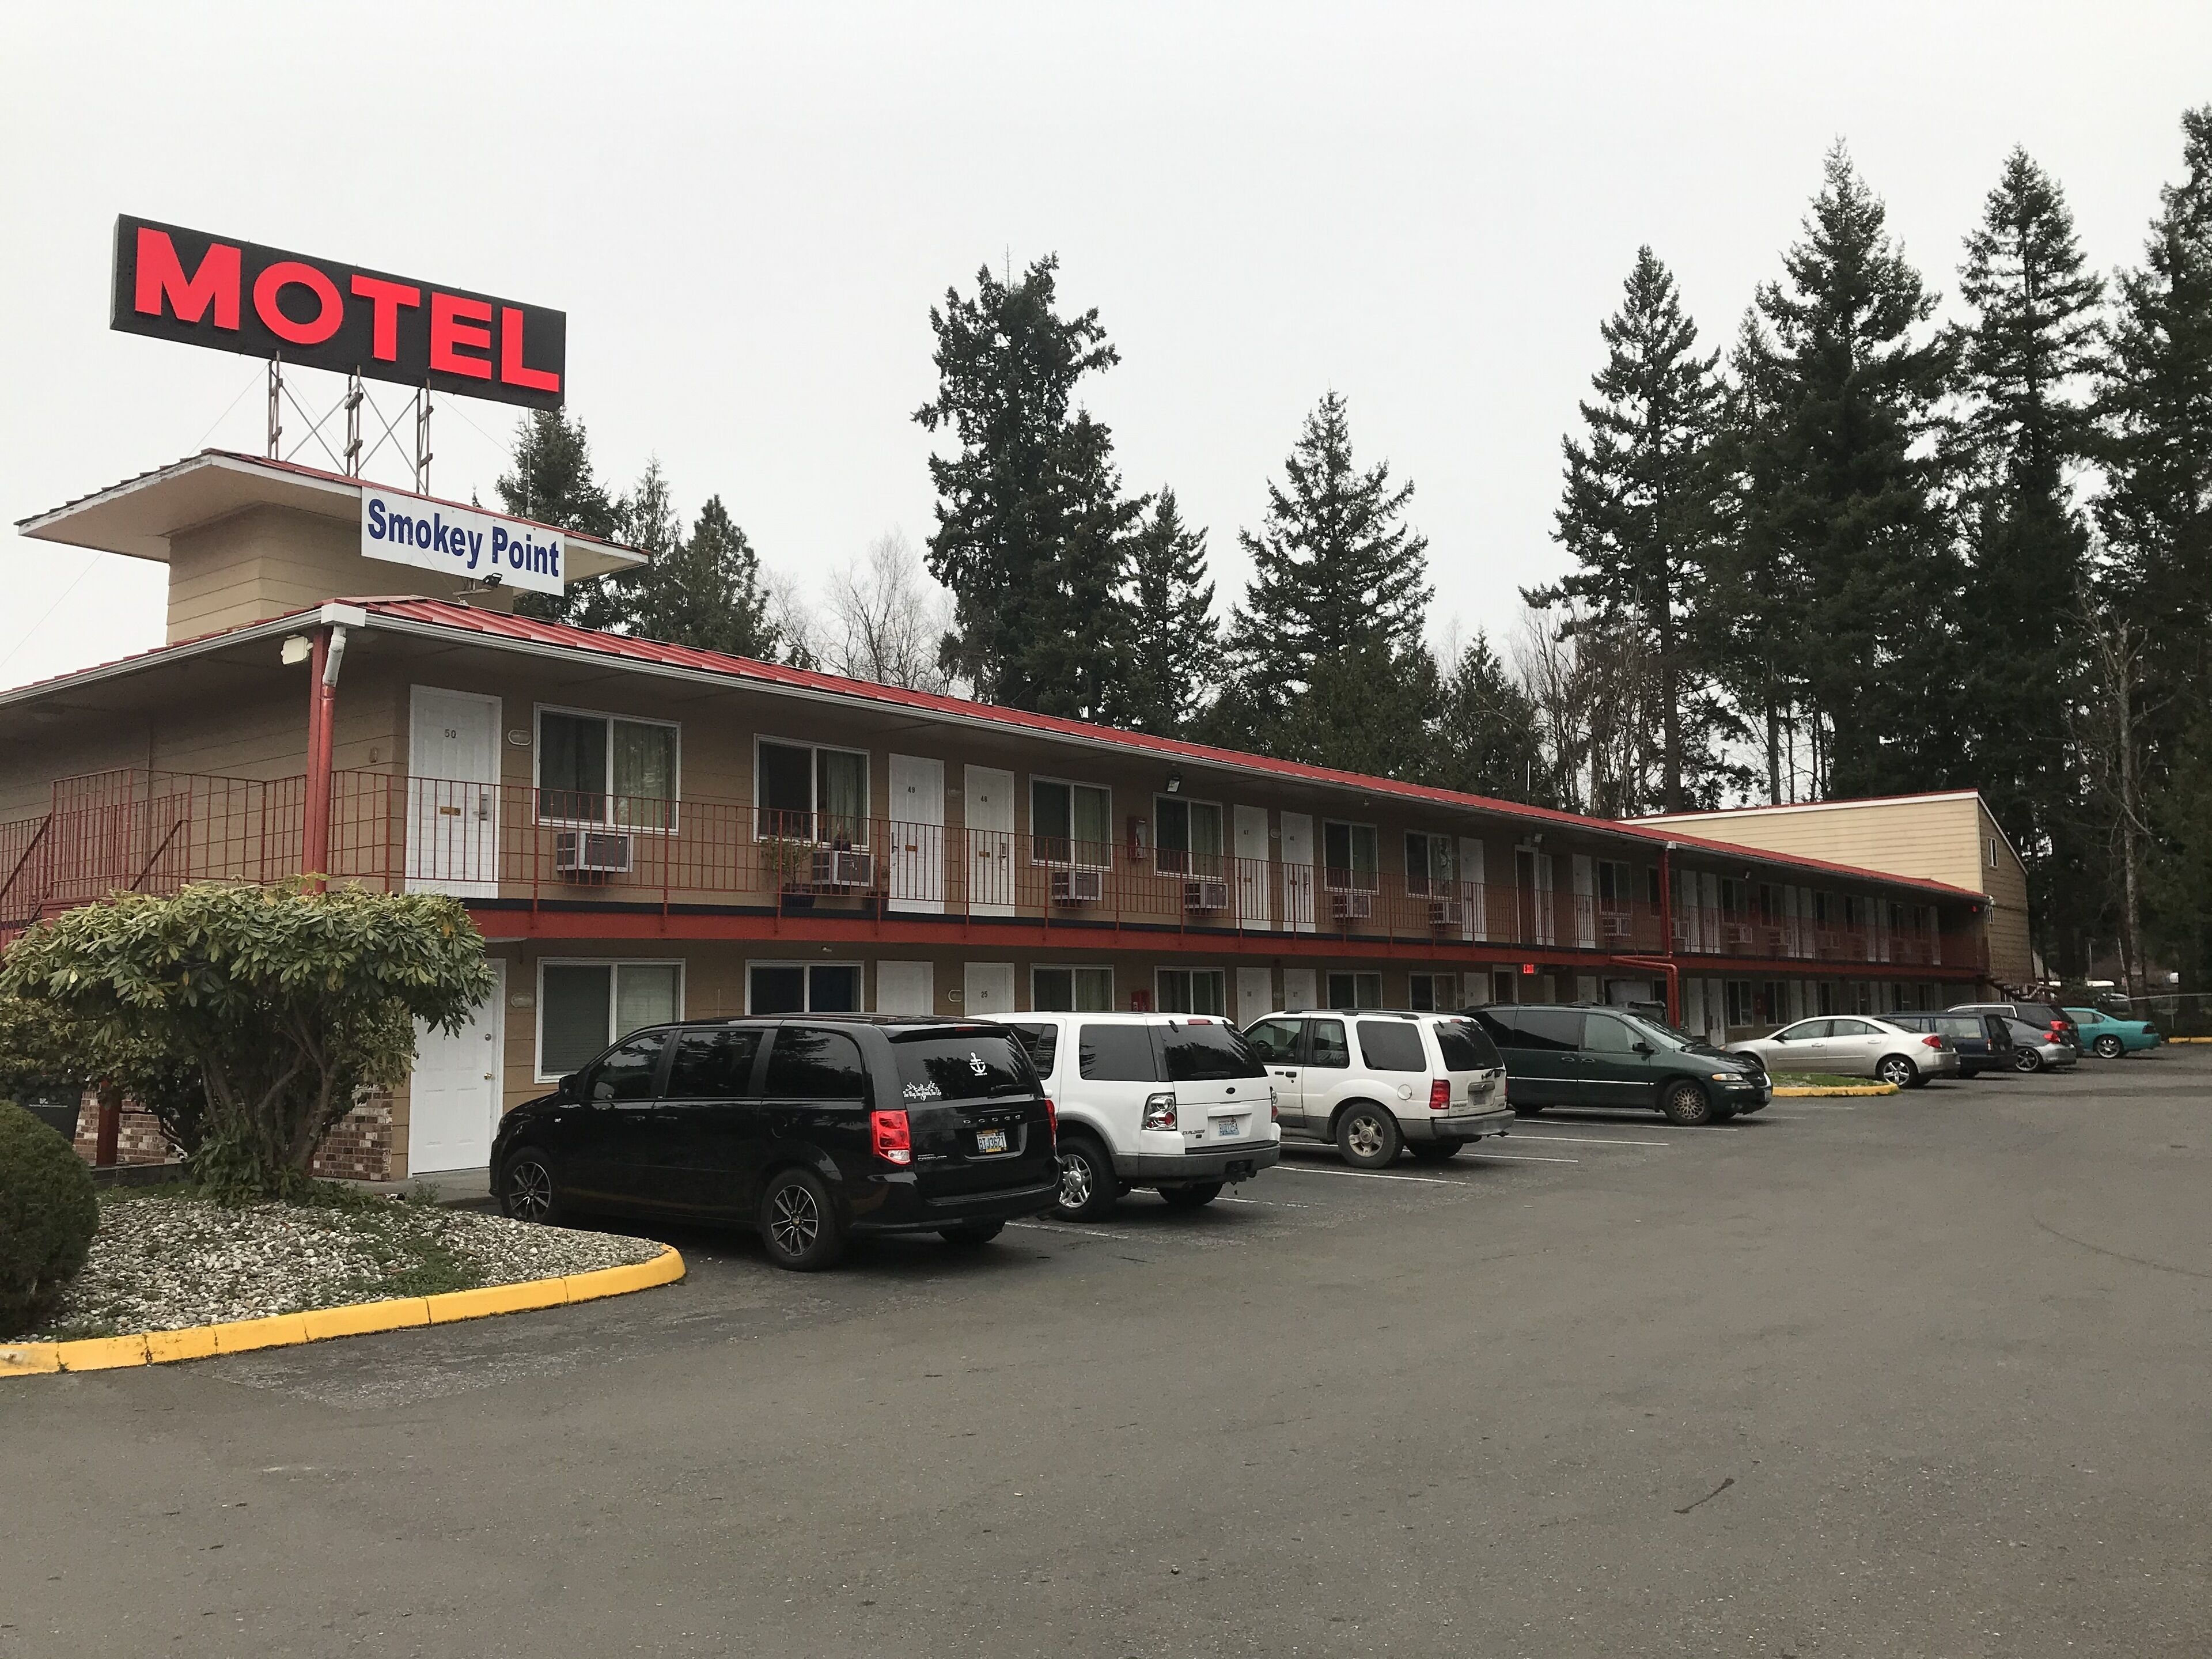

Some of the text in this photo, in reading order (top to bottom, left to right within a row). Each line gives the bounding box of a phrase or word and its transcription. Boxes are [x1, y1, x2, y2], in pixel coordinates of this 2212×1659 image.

[135, 228, 559, 392] MOTEL
[368, 499, 559, 577] Smokey Point
[445, 729, 456, 738] 50
[963, 1115, 1021, 1124] DODGE
[979, 1136, 1005, 1150] BTJ3621
